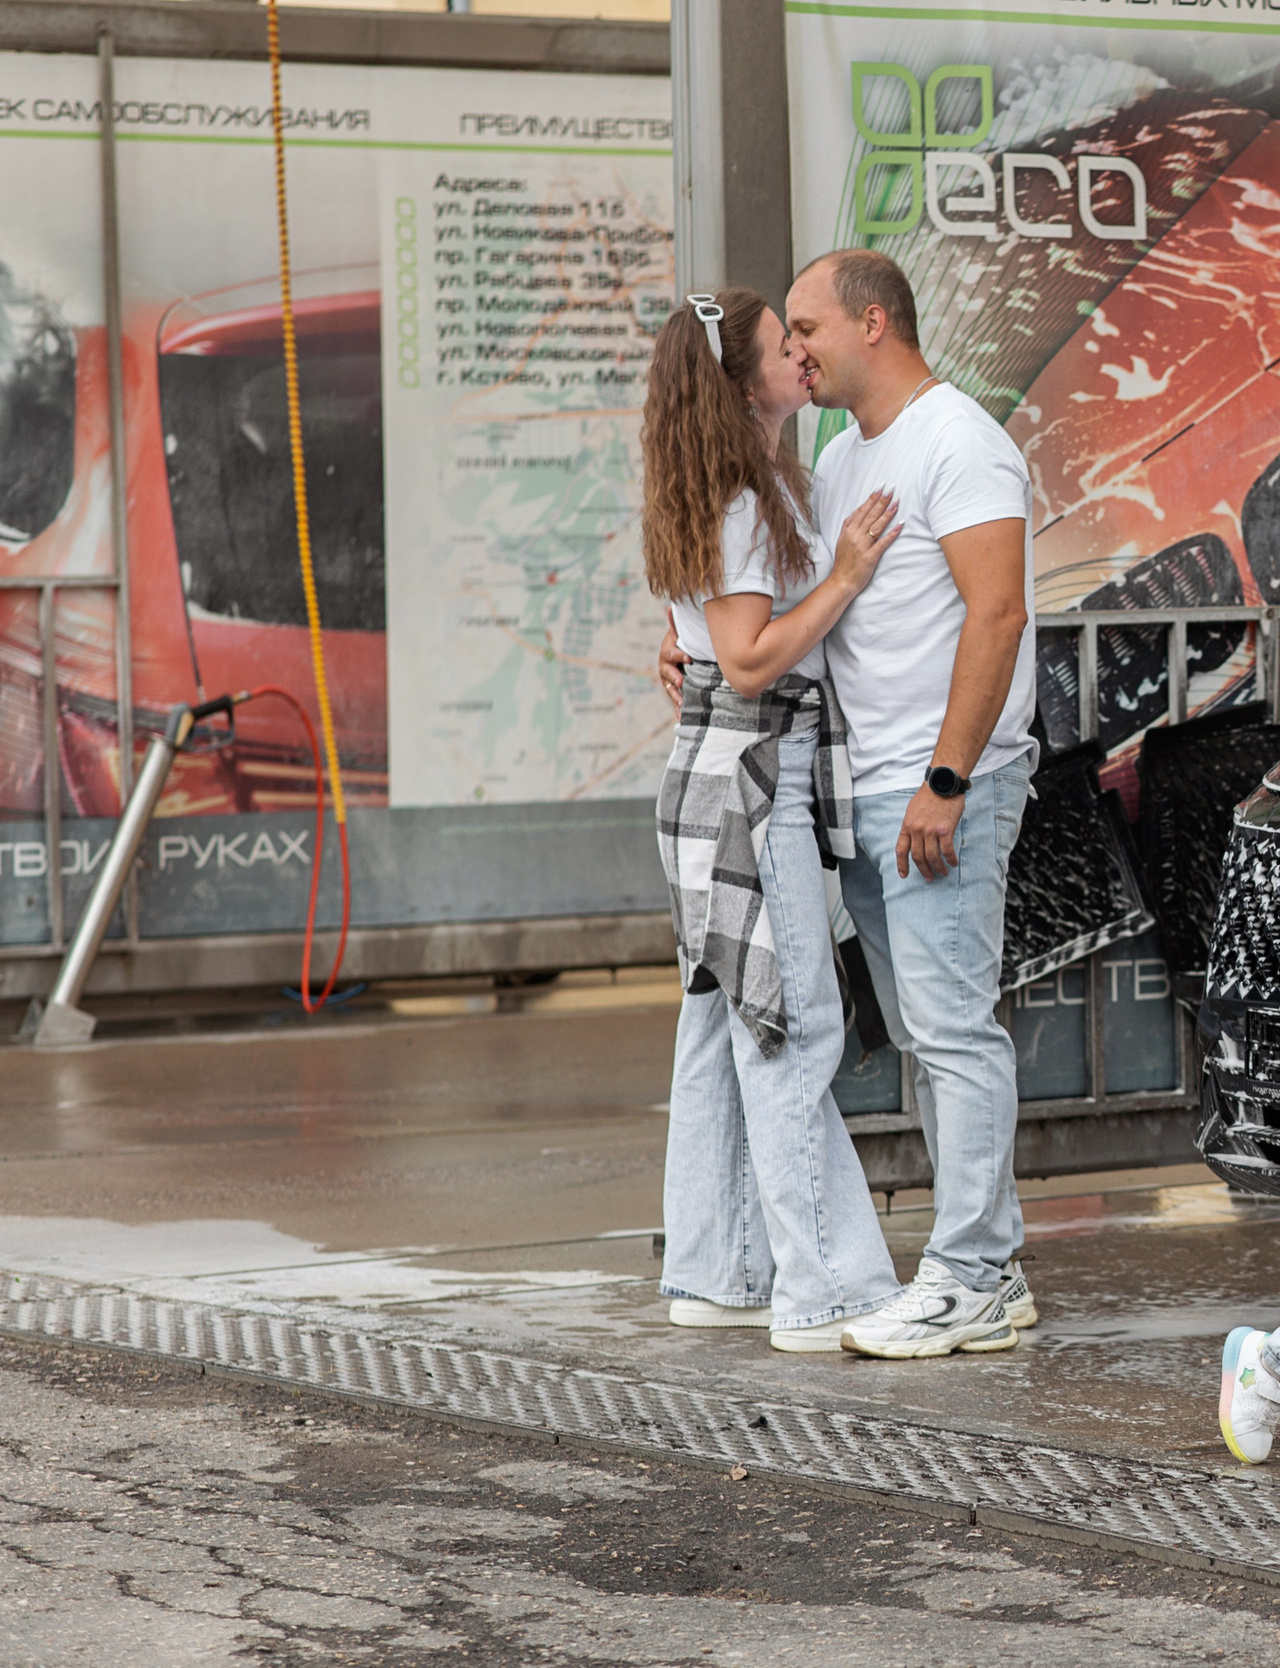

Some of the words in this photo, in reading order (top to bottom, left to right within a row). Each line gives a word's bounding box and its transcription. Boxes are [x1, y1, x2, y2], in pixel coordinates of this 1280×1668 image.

[459, 113, 673, 142] ПРЕИМУЩЕСТВ
[925, 150, 1148, 240] eco
[159, 829, 311, 869] РУКАХ
